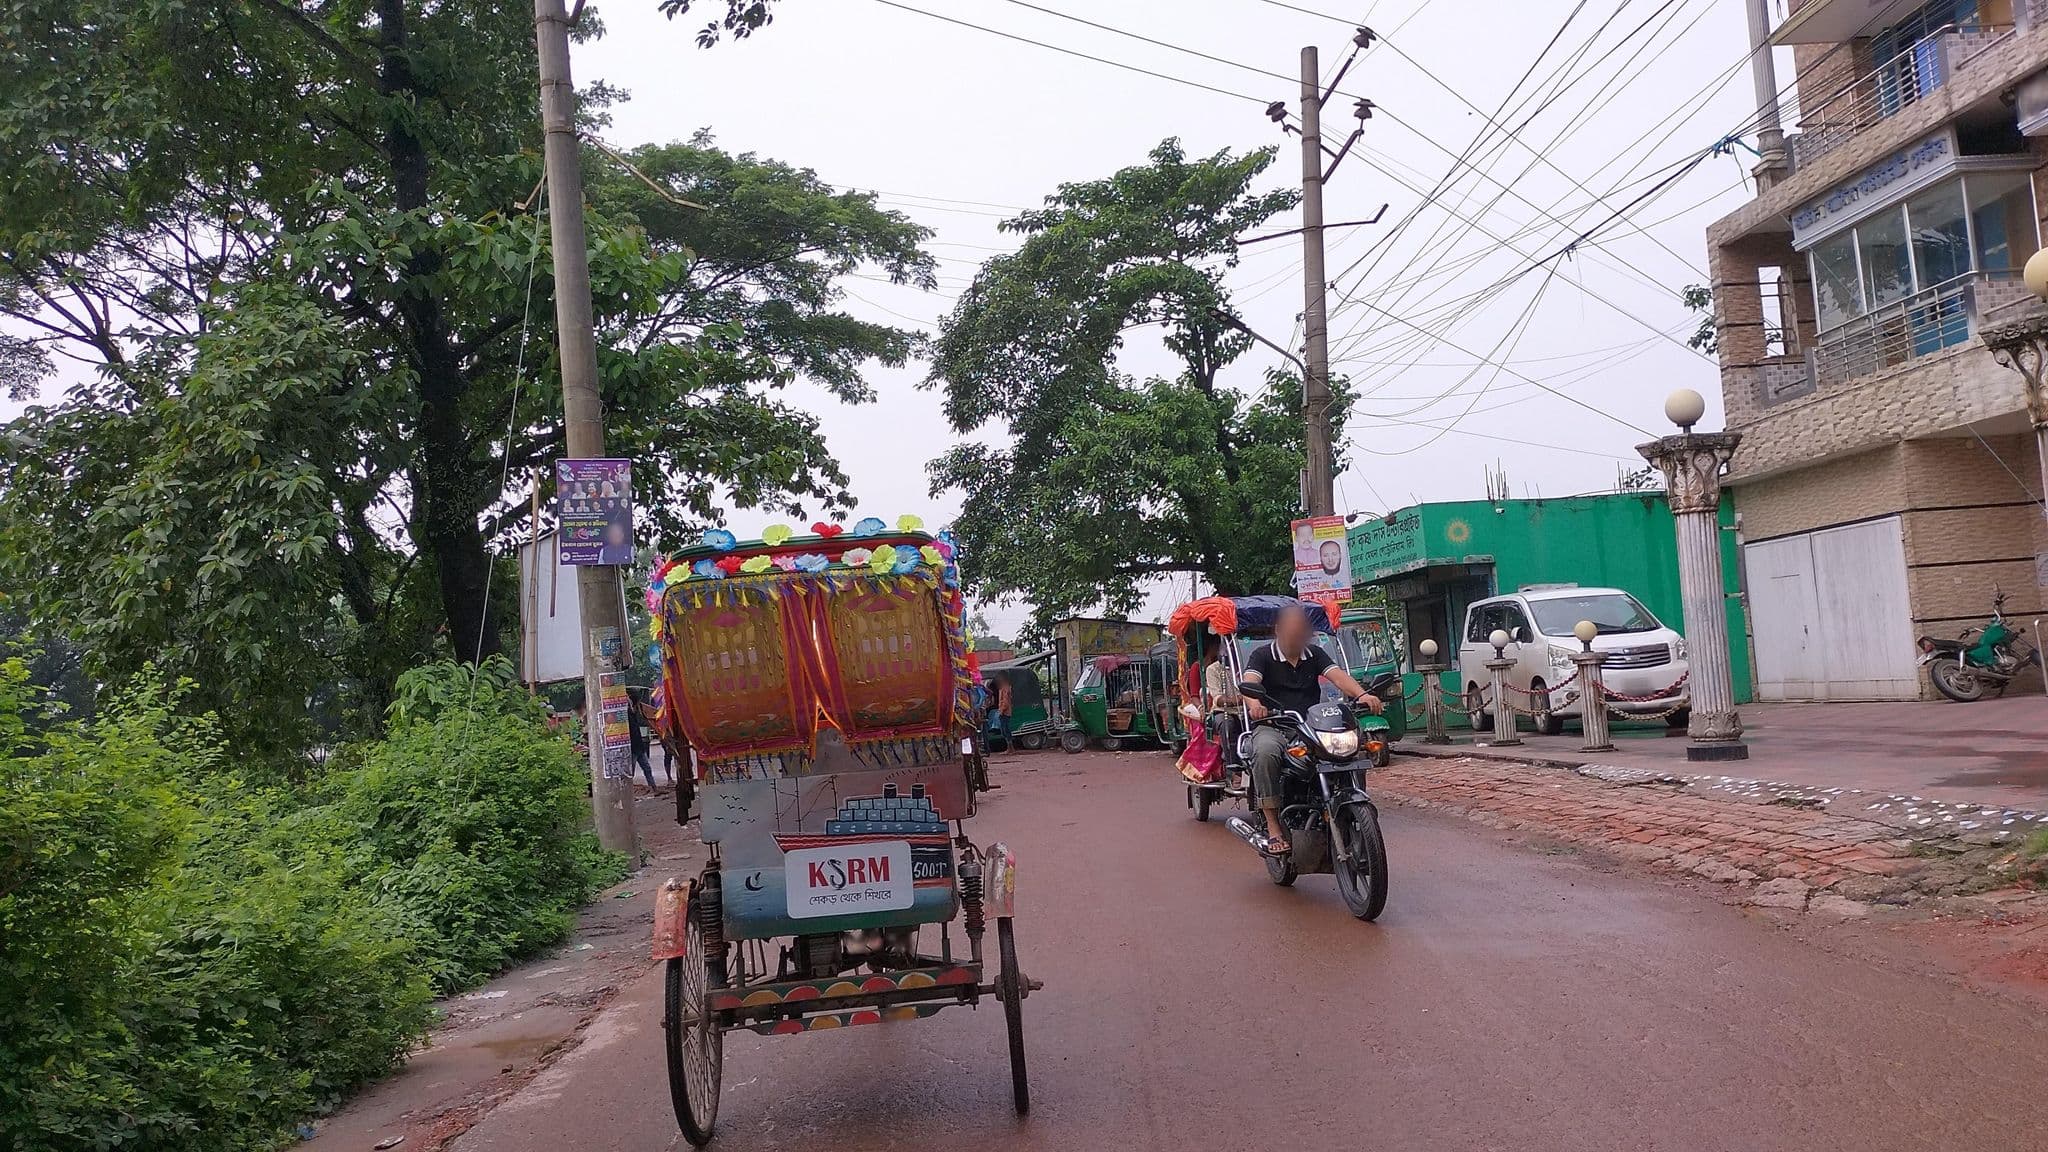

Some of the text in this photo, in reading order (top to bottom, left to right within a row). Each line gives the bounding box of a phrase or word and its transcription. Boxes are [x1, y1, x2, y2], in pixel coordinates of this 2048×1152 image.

[808, 856, 890, 890] KSRM
[840, 892, 862, 903] থেকে
[864, 888, 892, 901] শিখরে
